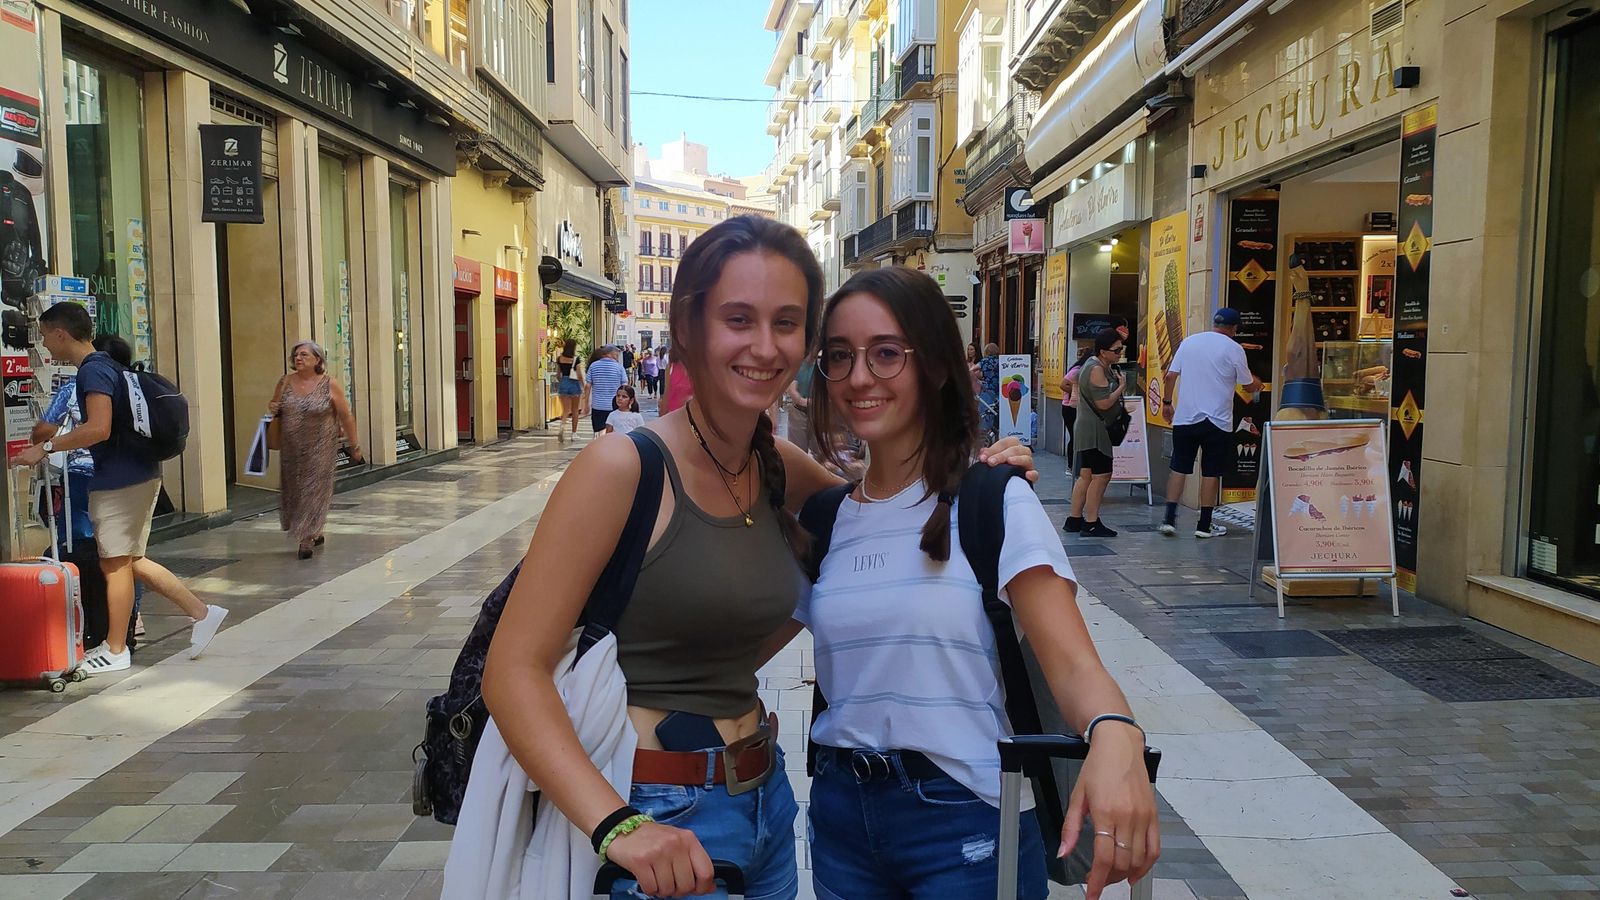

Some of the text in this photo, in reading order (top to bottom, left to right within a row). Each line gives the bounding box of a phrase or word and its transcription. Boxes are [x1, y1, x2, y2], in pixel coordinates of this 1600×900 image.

[163, 11, 210, 44] FASHION
[301, 55, 353, 119] ZERIMAR
[1212, 41, 1399, 171] JECHURA
[399, 134, 412, 148] SINCE
[210, 159, 252, 167] ZERIMAR
[90, 274, 117, 295] SALE
[1310, 552, 1358, 560] JECHURA
